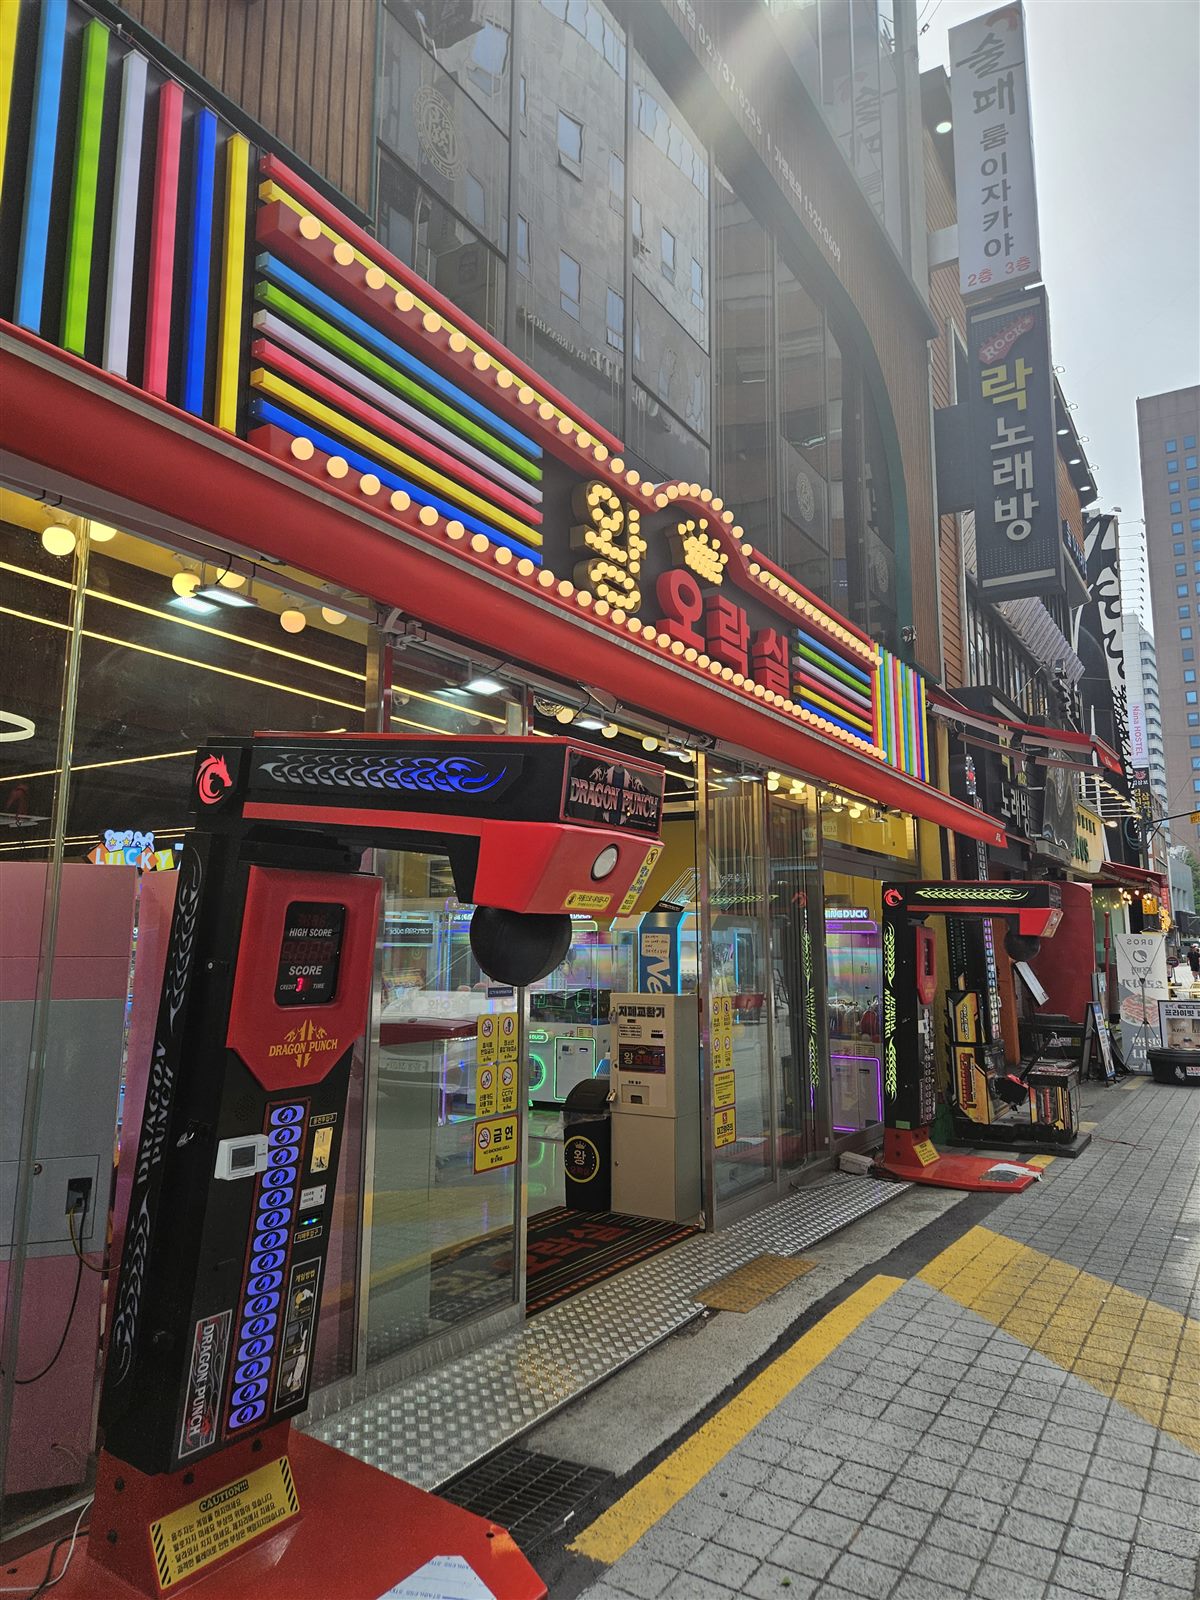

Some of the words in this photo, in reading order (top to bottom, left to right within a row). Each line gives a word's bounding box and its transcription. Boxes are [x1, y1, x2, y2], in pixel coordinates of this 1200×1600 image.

[980, 123, 1014, 257] 룸이자카야
[968, 268, 993, 287] 2층
[1005, 256, 1031, 275] 3층
[984, 325, 1026, 361] ROCK
[981, 358, 1033, 411] 락
[990, 417, 1039, 541] 노래방
[578, 480, 647, 613] 왕
[656, 569, 790, 700] 오락실
[1134, 726, 1144, 756] HOSTEL
[570, 777, 620, 811] DRAGON
[621, 789, 659, 818] PUNCH
[95, 846, 171, 869] LUCKY
[289, 928, 308, 937] HIGH
[309, 928, 332, 937] SCORE
[288, 965, 323, 976] SCORE
[618, 1006, 666, 1018] 지폐교환기
[269, 1042, 307, 1057] DRAGON
[309, 1039, 338, 1052] PUNCH
[624, 1052, 634, 1065] 왕
[493, 1125, 514, 1144] 금연
[573, 1149, 586, 1166] 왕
[196, 1323, 215, 1383] DRAGON
[190, 1384, 207, 1436] PUNCH
